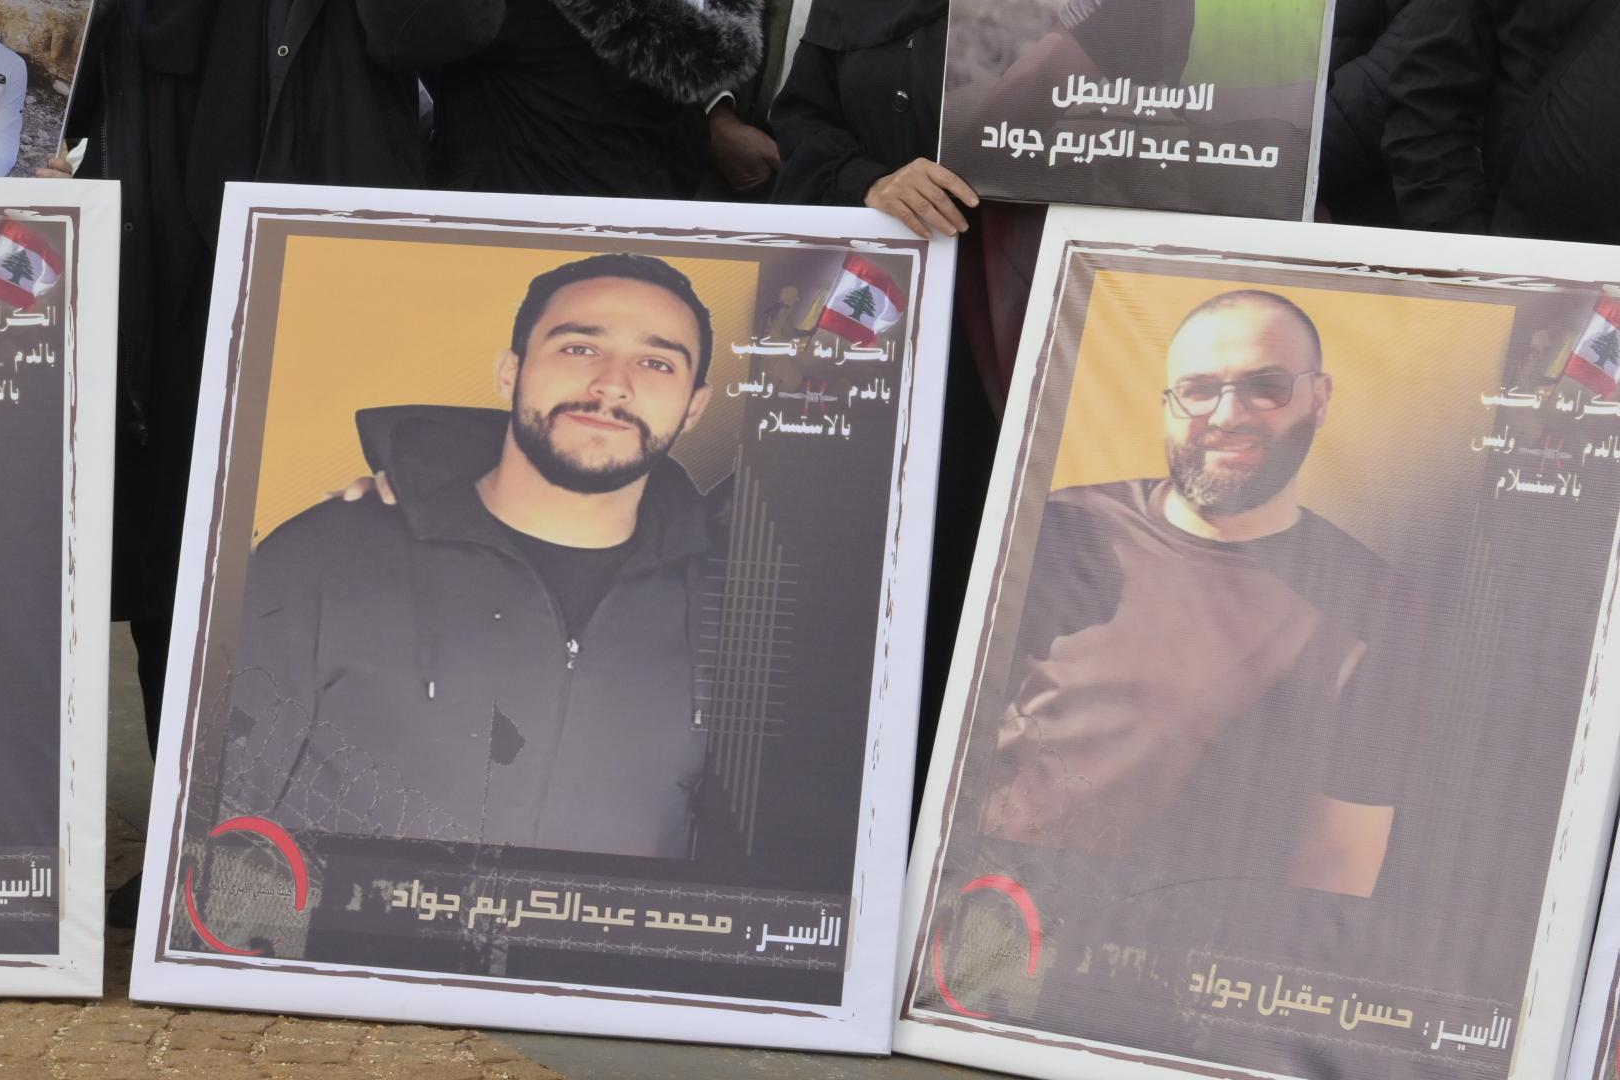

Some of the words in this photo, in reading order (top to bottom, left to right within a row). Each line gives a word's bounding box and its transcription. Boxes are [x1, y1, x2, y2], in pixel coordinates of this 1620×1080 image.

[1052, 74, 1130, 113] البطل
[1133, 83, 1214, 116] الاسير
[981, 121, 1045, 158] جواد
[1048, 128, 1135, 167] الكريم
[1139, 135, 1190, 169] عبد
[1195, 142, 1279, 168] محمد
[14, 343, 55, 373] بالدم
[731, 335, 800, 359] تكتب
[813, 337, 896, 366] الكرامة
[726, 371, 774, 398] وليس
[848, 378, 891, 408] بالدم
[1481, 386, 1545, 411] تكتب
[1556, 390, 1620, 420] كرامة
[758, 411, 851, 441] بالاستسلام
[1471, 424, 1515, 454] وليس
[1495, 468, 1581, 502] بالاستسلام
[392, 879, 461, 921] جواد
[644, 909, 733, 934] محمد
[1189, 963, 1252, 1009] جواد
[1257, 974, 1334, 1017] عقيل
[1339, 992, 1414, 1031] حسن
